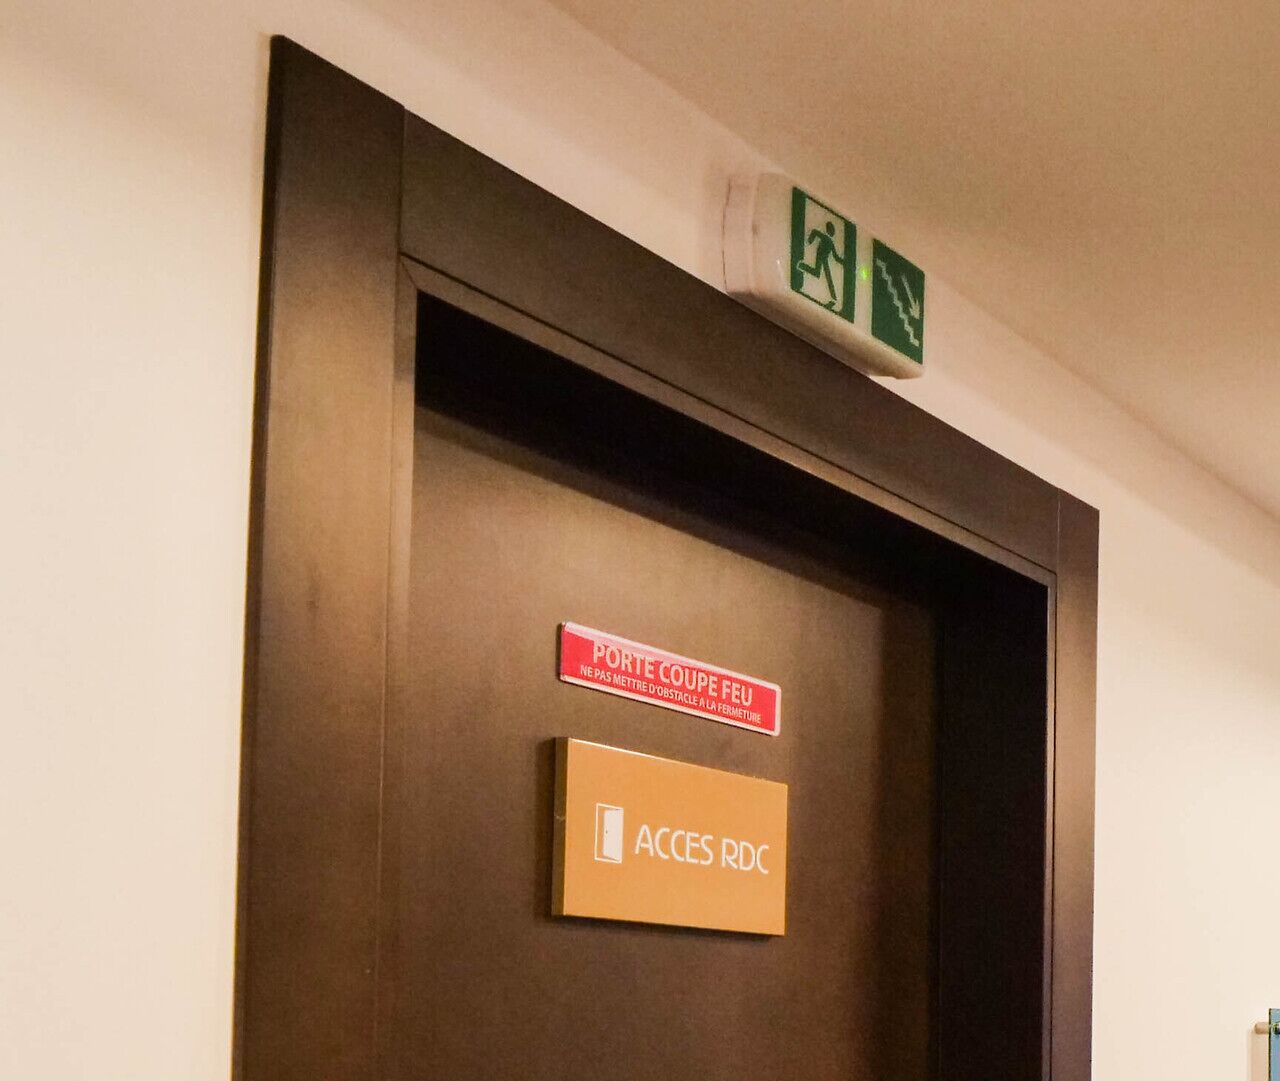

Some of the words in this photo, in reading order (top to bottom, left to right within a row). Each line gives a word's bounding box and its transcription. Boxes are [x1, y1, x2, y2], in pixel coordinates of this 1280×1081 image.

[580, 664, 594, 678] NE
[594, 668, 612, 683] PAS
[612, 673, 648, 692] METTRE
[648, 683, 698, 706] D'OBSTACLE
[706, 699, 717, 712] LA
[717, 702, 762, 724] FERMETURE
[593, 640, 654, 679] PORTE
[659, 661, 718, 697] COUPE
[722, 680, 752, 706] FEU
[634, 824, 714, 866] ACCES
[721, 838, 770, 875] RDC
